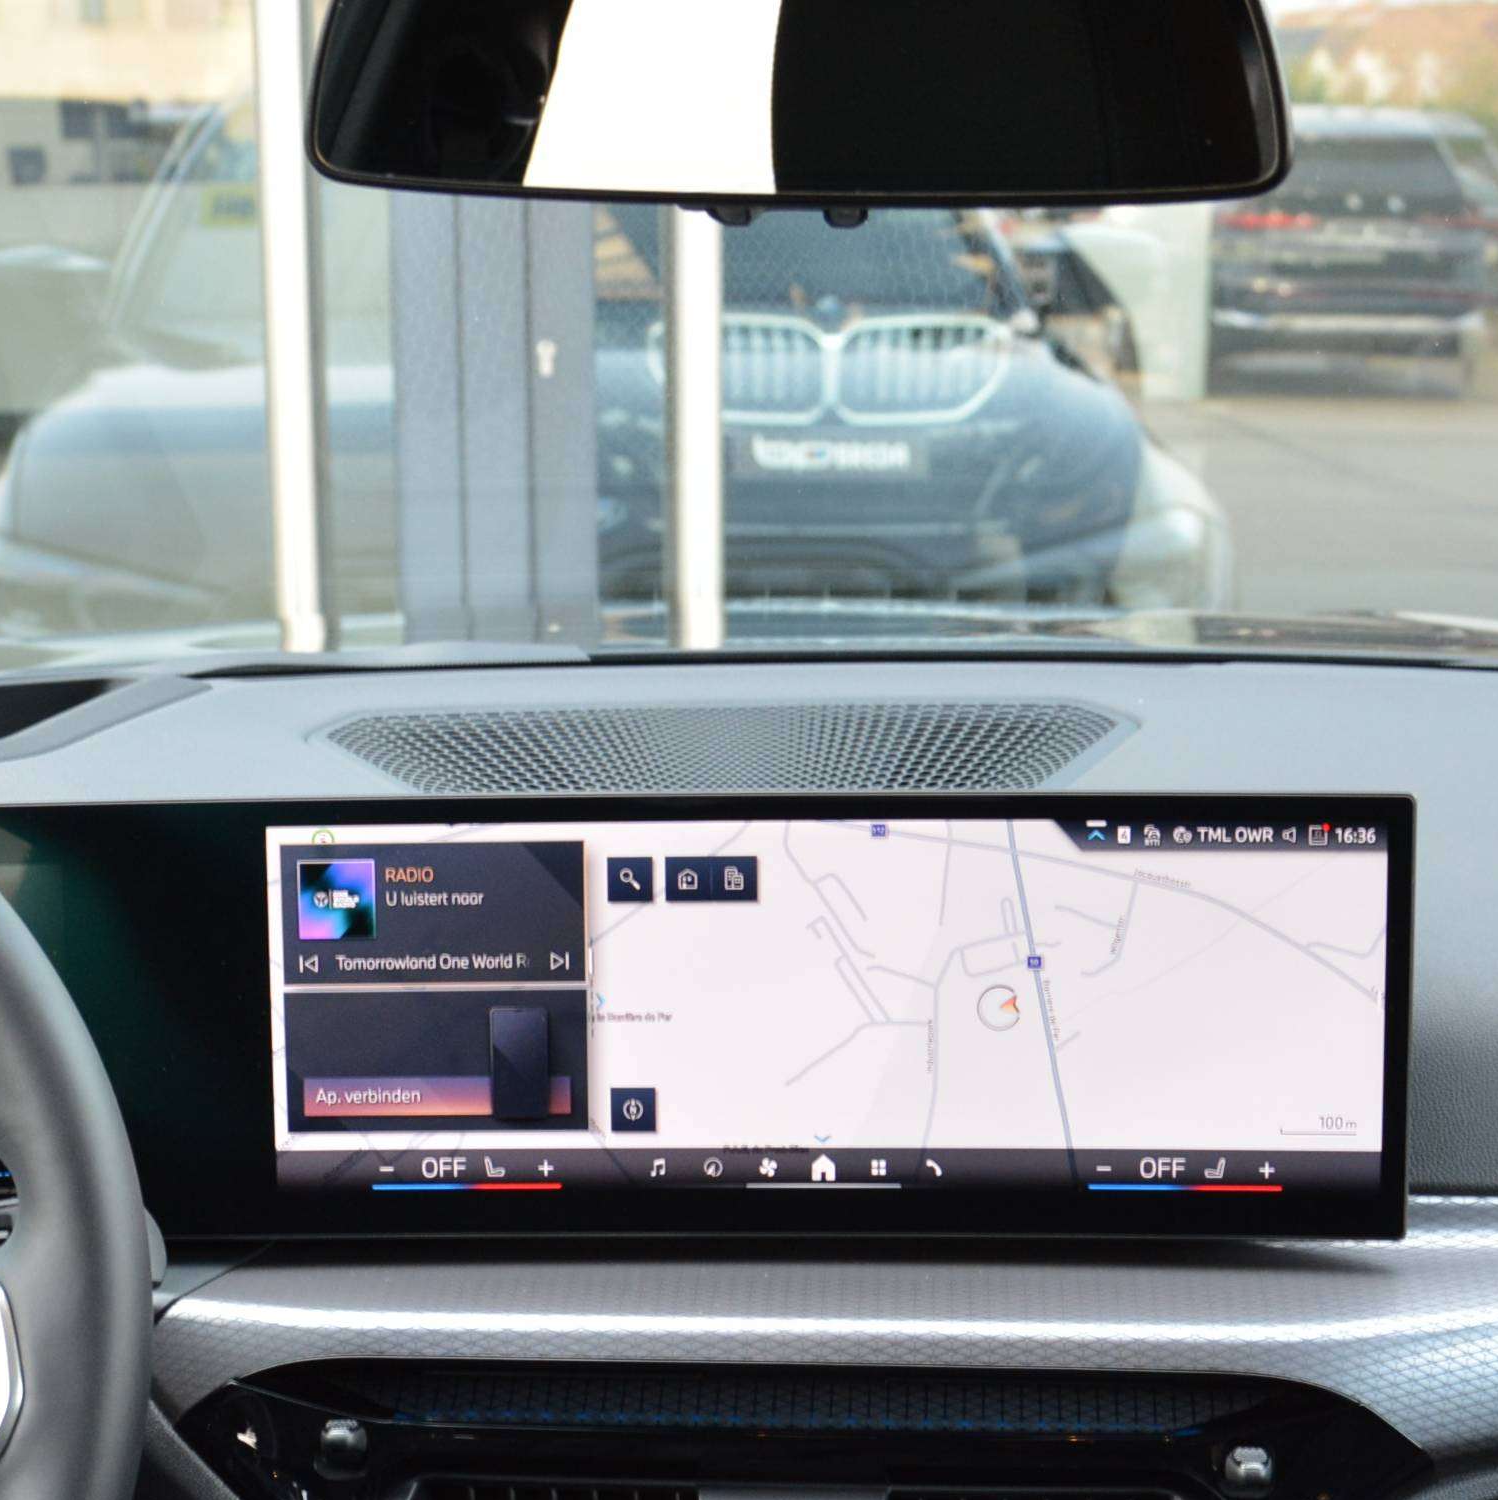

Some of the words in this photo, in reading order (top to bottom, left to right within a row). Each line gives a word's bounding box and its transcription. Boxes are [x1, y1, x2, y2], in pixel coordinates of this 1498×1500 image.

[1197, 827, 1231, 843] TML
[1234, 826, 1274, 843] OWR
[1335, 827, 1376, 844] 16:36
[385, 867, 434, 883] RADIO
[385, 893, 398, 907] U
[401, 891, 449, 907] luistert
[451, 893, 484, 906] naar
[335, 954, 436, 971] Tomorrowland
[439, 954, 469, 970] One
[472, 953, 513, 969] World
[315, 1089, 342, 1106] Ap.
[345, 1089, 421, 1105] verbinden
[1319, 1116, 1344, 1130] 100
[1345, 1120, 1358, 1129] m
[421, 1156, 467, 1178] OFF
[1139, 1157, 1186, 1179] OFF
